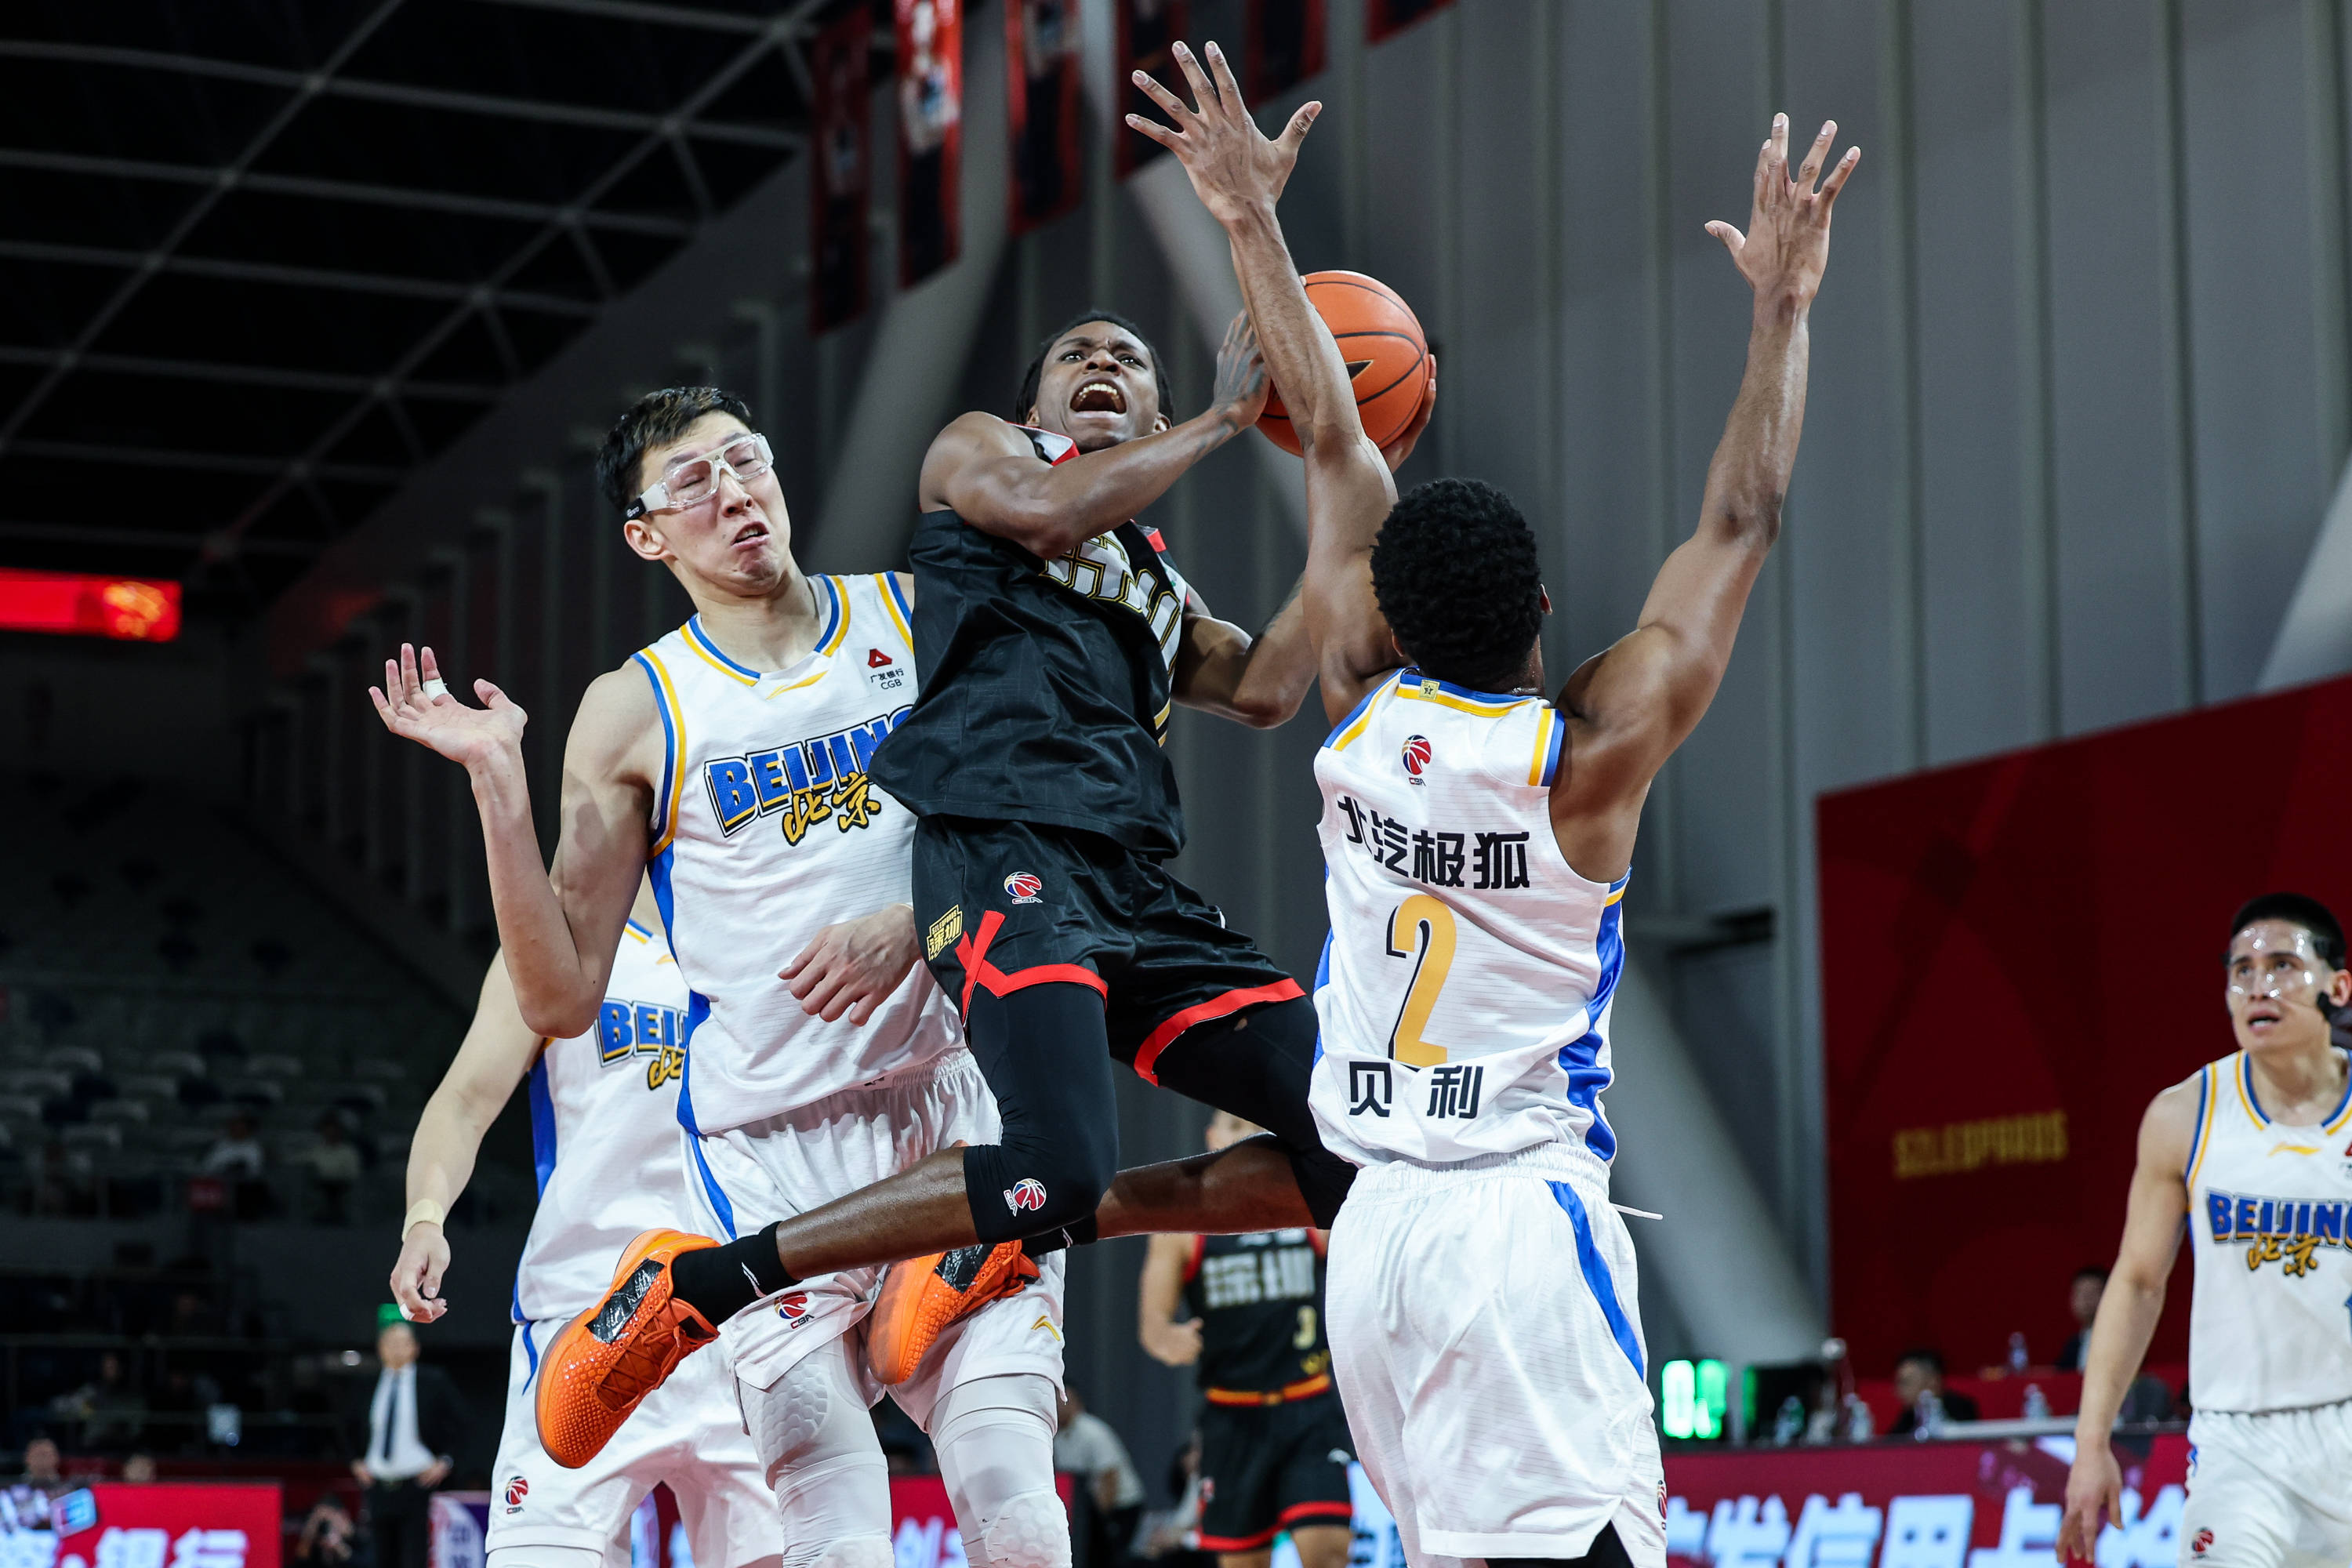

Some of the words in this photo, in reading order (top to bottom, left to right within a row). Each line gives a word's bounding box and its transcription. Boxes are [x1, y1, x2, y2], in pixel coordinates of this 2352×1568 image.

[880, 679, 902, 690] CGB
[704, 704, 913, 837] BEIJIN
[782, 771, 881, 846] 北京
[1338, 796, 1530, 889] 北汽极狐
[1386, 895, 1457, 1073] 2
[1348, 1061, 1483, 1119] 贝利
[2206, 1187, 2352, 1252] BEIJIN
[2247, 1232, 2322, 1278] 北京
[790, 1315, 815, 1329] CBA
[1294, 1305, 1316, 1349] 3
